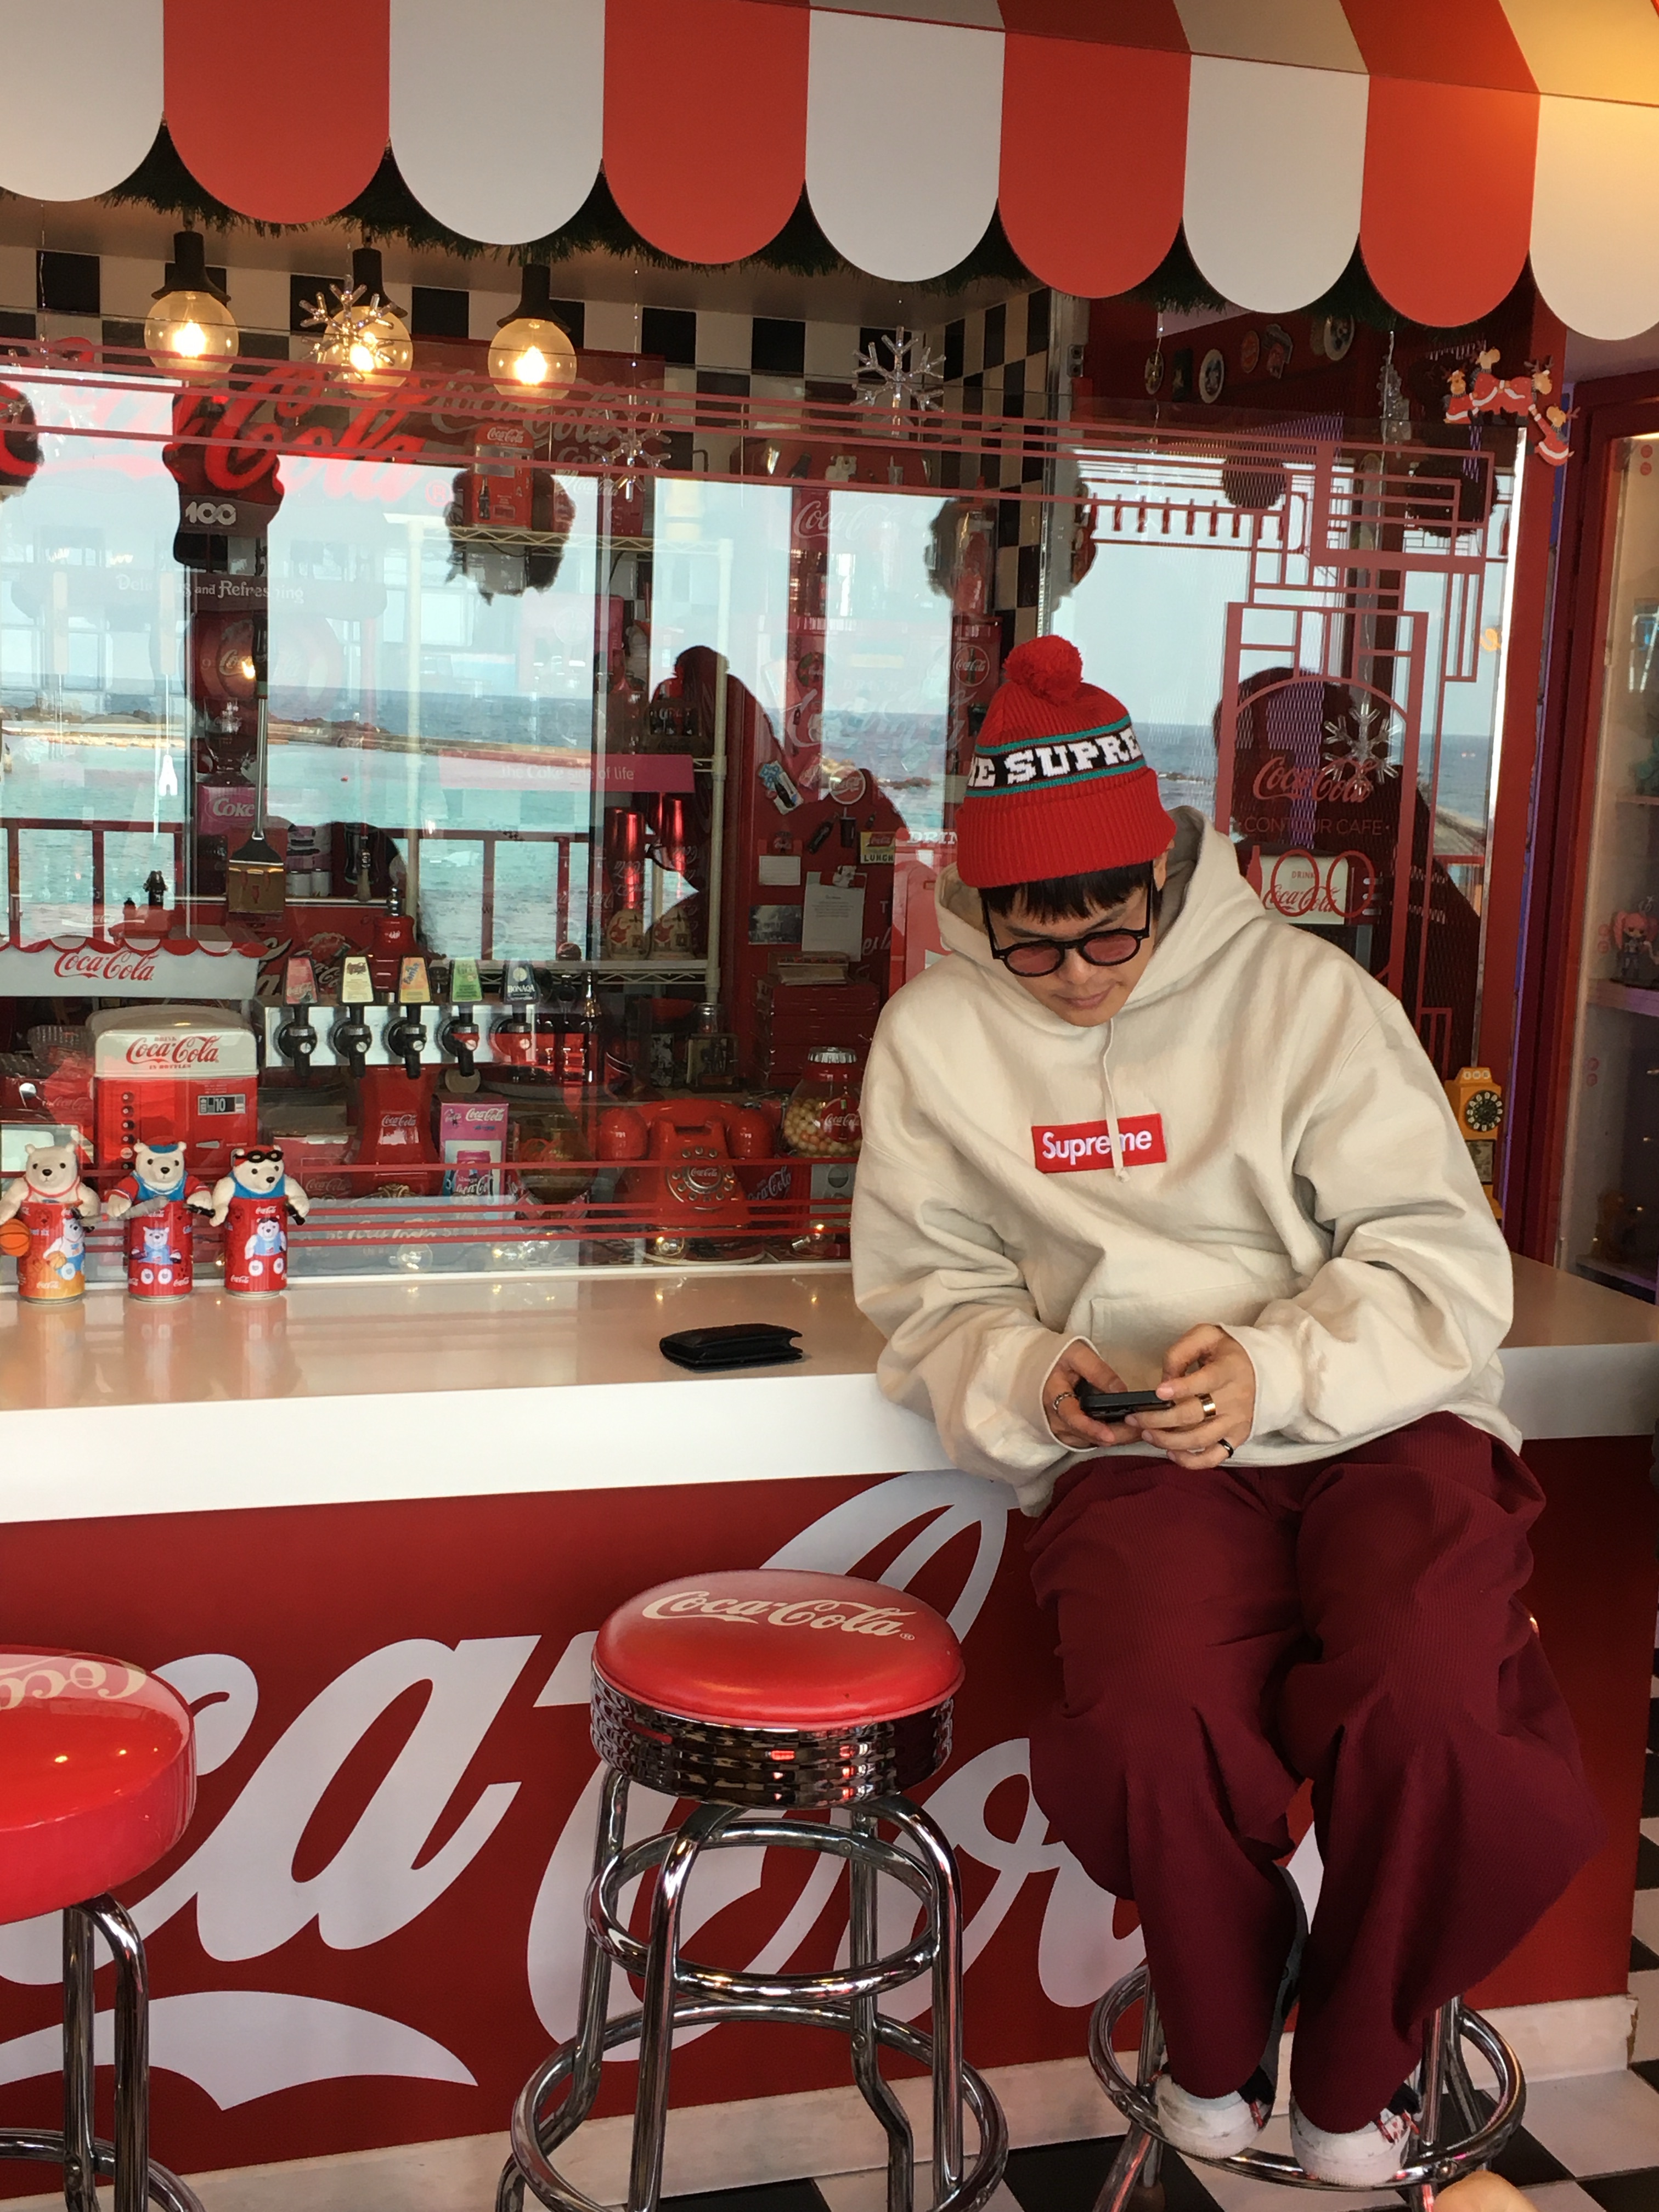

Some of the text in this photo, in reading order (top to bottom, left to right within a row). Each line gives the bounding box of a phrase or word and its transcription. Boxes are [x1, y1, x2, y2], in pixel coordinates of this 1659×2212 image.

[487, 427, 524, 444] Coca-Cola
[185, 501, 236, 526] 100
[194, 584, 216, 595] and
[501, 766, 634, 780] the Coke side of life
[1252, 757, 1378, 803] Coca-Cola
[213, 797, 255, 817] Coke
[1336, 819, 1383, 836] CAFE
[1262, 884, 1341, 913] Coca-Cola
[55, 950, 158, 981] Coca-Cola
[126, 1036, 221, 1064] Coca-Cola
[215, 1098, 226, 1112] 10
[381, 1114, 417, 1127] Coca-Cola
[465, 1108, 504, 1122] Coca-Cola
[1042, 1128, 1153, 1165] Supreme
[690, 1167, 718, 1177] Coca-Cola
[305, 1178, 352, 1195] Coca-Cola
[642, 1590, 917, 1637] Coca-Cola
